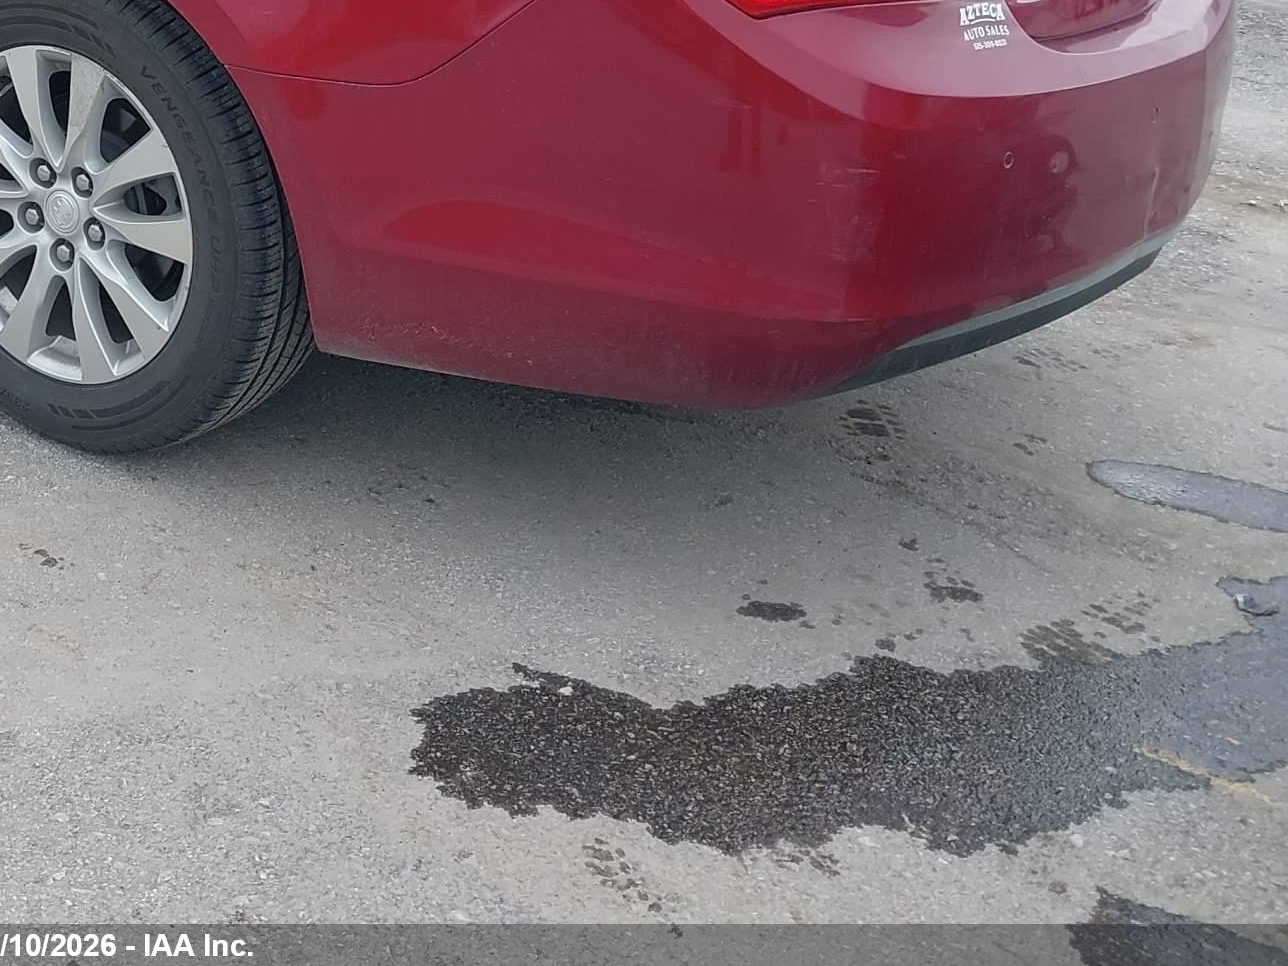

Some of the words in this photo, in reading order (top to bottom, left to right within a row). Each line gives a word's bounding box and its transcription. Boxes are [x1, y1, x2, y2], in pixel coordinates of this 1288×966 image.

[959, 2, 1005, 25] AZTECA
[964, 26, 985, 41] AUTO
[985, 24, 1009, 36] SALES
